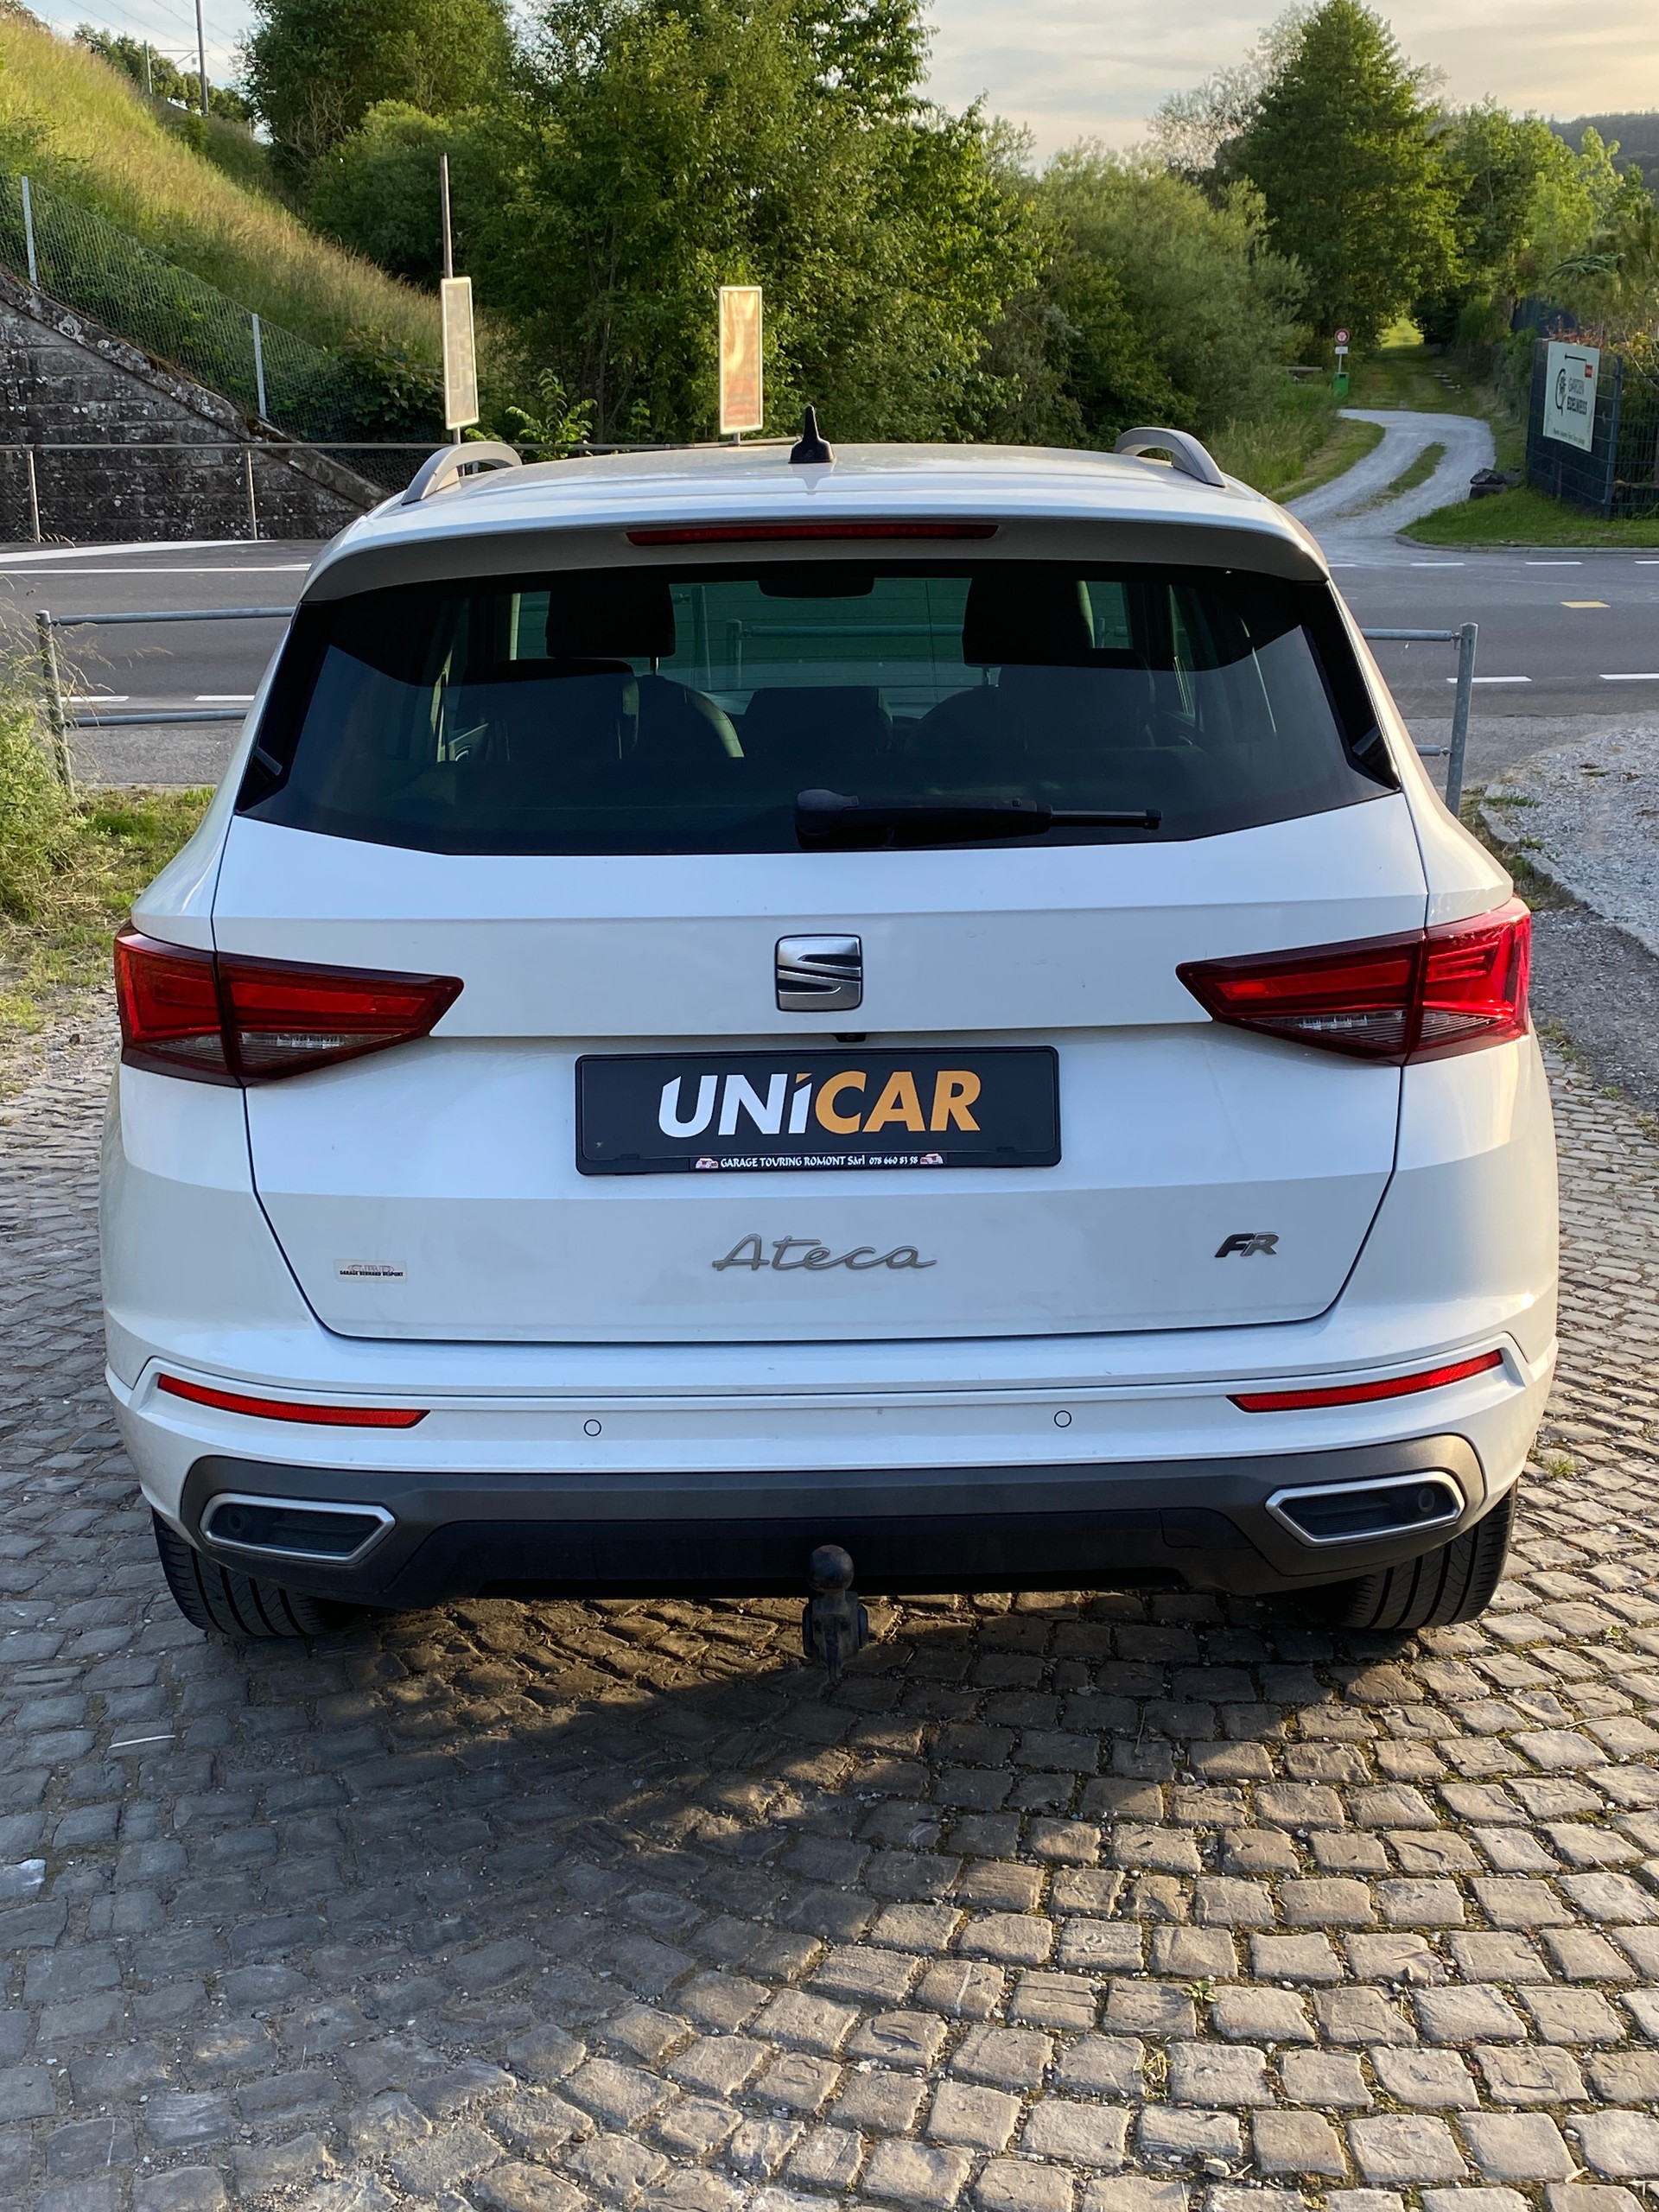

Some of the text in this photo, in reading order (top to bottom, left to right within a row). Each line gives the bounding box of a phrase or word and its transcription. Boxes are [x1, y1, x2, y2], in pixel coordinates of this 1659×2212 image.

[721, 1158, 758, 1168] GARAGE
[760, 1157, 802, 1167] TOURING
[804, 1156, 846, 1166] ROMONT
[869, 1156, 882, 1165] 078
[884, 1156, 898, 1165] 660
[712, 1234, 937, 1271] Ateca
[1215, 1232, 1279, 1258] FR
